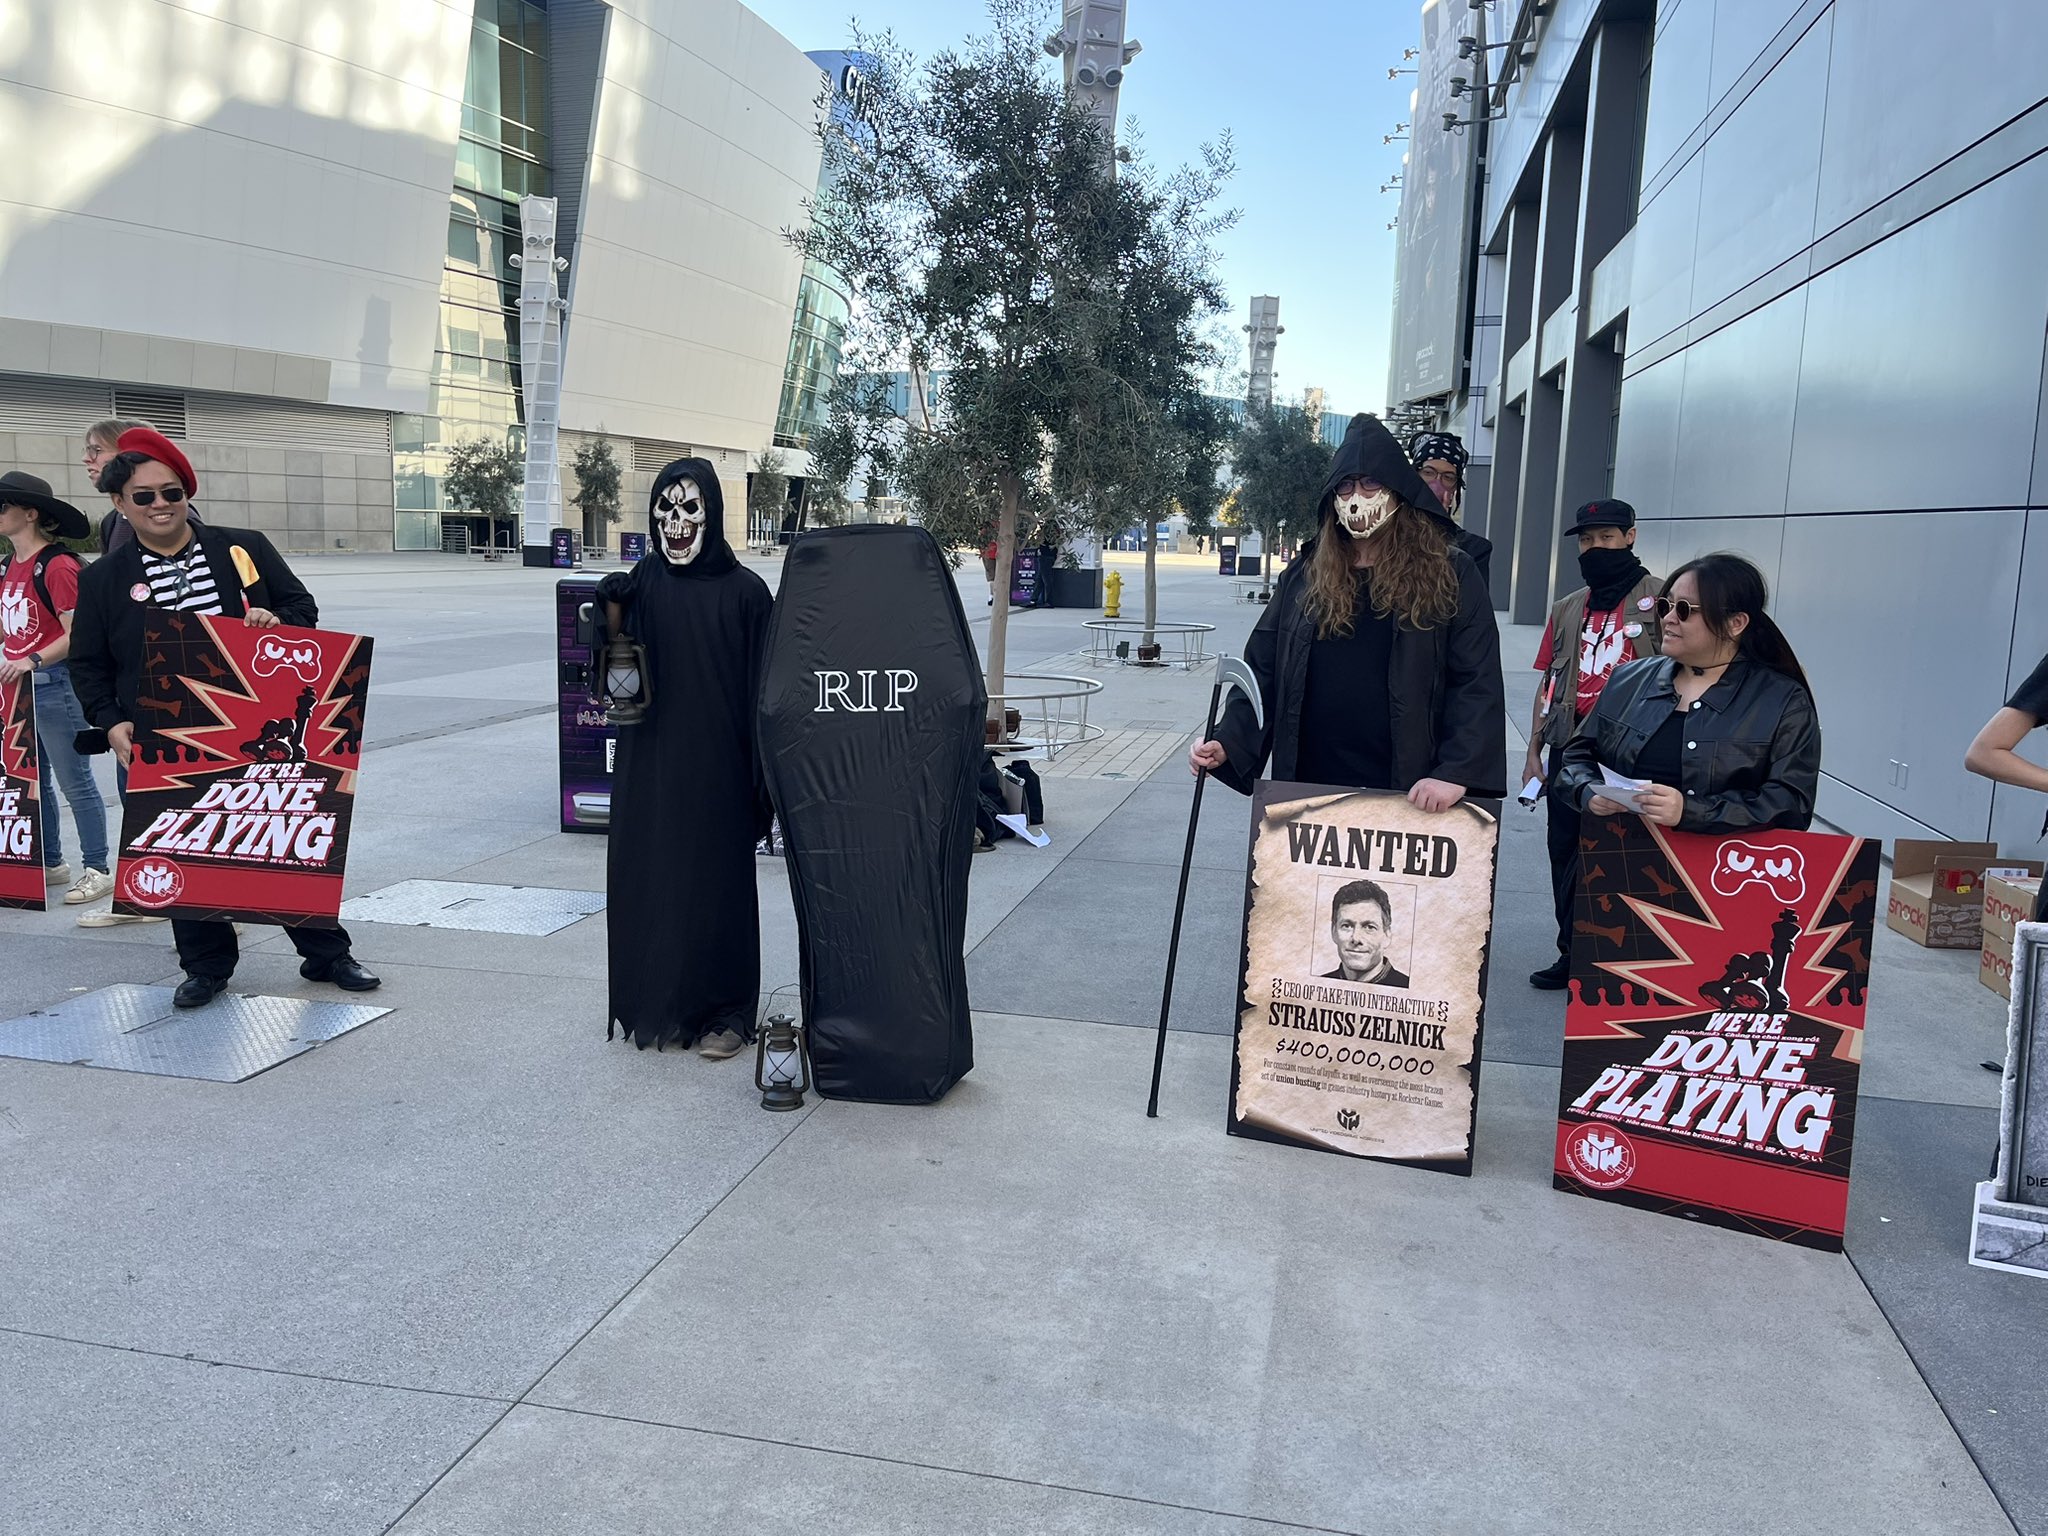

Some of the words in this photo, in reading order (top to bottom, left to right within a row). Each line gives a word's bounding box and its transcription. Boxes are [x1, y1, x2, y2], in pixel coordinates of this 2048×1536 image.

[814, 669, 918, 712] RIP
[243, 763, 306, 779] WE'RE
[192, 782, 325, 812] DONE
[130, 812, 336, 861] PLAYING
[1287, 822, 1457, 879] WANTED
[1888, 897, 1924, 927] snack
[1283, 981, 1301, 999] CEO
[1303, 983, 1316, 1001] OF
[1316, 985, 1367, 1008] TAKE-TWO
[1367, 993, 1435, 1018] INTERACTIVE
[1268, 1001, 1356, 1038] STRAUSS
[1358, 1014, 1447, 1051] ZELNICK
[1705, 1012, 1788, 1034] WE'RE
[1273, 1060, 1296, 1072] constant
[1399, 1079, 1409, 1089] the
[1276, 1038, 1434, 1075] $400,000,000
[1642, 1034, 1817, 1083] DONE
[1276, 1074, 1294, 1085] union
[1295, 1076, 1321, 1090] busting
[1398, 1092, 1424, 1105] Rockstar
[1571, 1067, 1834, 1153] PLAYING
[1692, 1132, 1737, 1145] brincando
